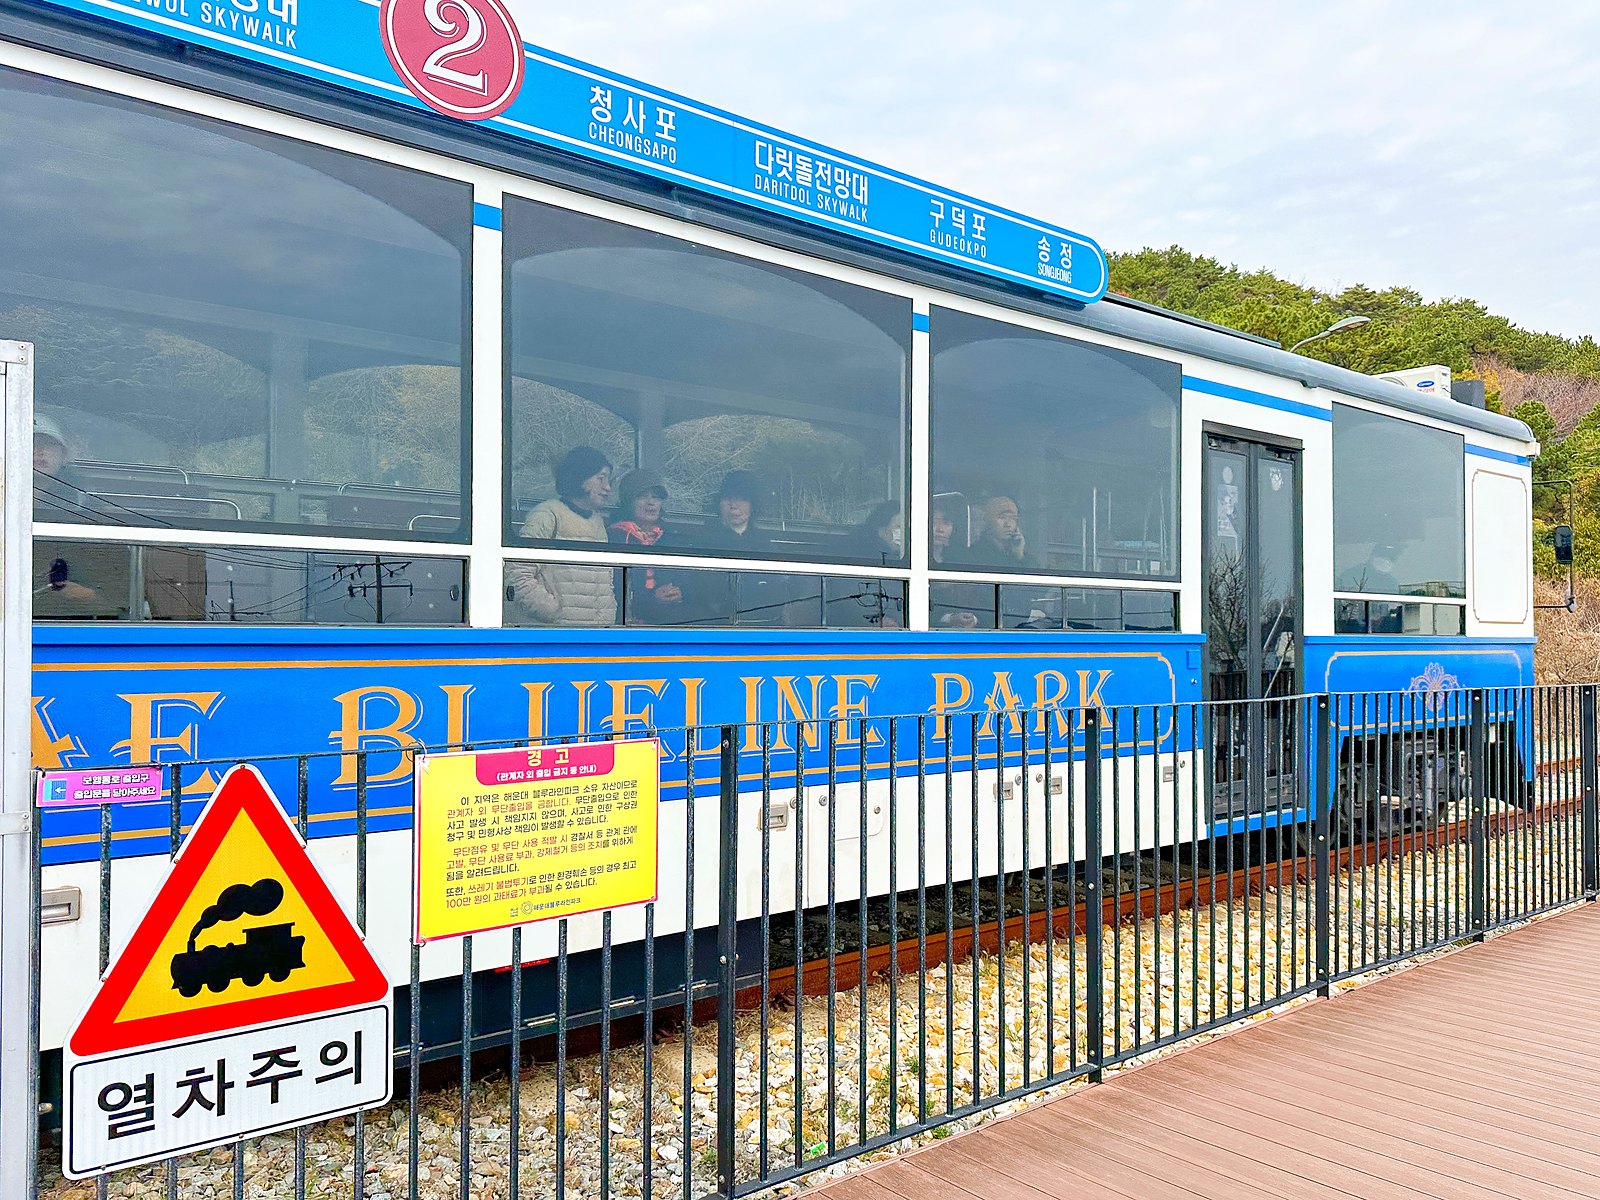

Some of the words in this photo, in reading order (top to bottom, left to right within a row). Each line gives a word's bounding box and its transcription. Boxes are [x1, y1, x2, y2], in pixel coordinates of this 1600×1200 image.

[200, 2, 297, 49] SKYWALK
[421, 0, 489, 97] 2
[588, 121, 677, 164] CHEONGSAPO
[754, 140, 868, 206] 다릿돌전망대
[754, 173, 811, 206] DARITDOL
[817, 193, 868, 223] SKYWALK
[929, 199, 986, 241] 구덕포
[930, 229, 987, 259] GUDEOKPO
[1037, 262, 1072, 285] SONGJEONG
[928, 669, 1114, 744] PARK
[122, 773, 150, 783] 출입구
[496, 771, 524, 782] (관계자
[526, 770, 534, 779] 외
[536, 768, 551, 778] 출입
[553, 767, 568, 777] 금지
[570, 766, 578, 775] 등
[579, 764, 597, 774] 안내)
[74, 789, 111, 799] 출입문을
[112, 786, 157, 798] 닫아주세요
[447, 807, 473, 819] 관계자
[478, 806, 487, 816] 외
[492, 801, 532, 814] 무단출입을
[575, 792, 619, 804] 무단출입으로
[623, 790, 637, 800] 인한
[461, 797, 469, 805] 이
[474, 794, 499, 804] 지역은
[503, 791, 528, 801] 해운대
[533, 786, 579, 798] 블루라인파크
[583, 784, 598, 793] 소유
[602, 780, 637, 791] 자산이므로
[447, 820, 464, 830] 사고
[469, 818, 487, 828] 발생
[491, 816, 500, 825] 시
[504, 812, 537, 823] 책임지지
[571, 805, 594, 816] 사고로
[598, 804, 612, 813] 인한
[616, 800, 638, 811] 구상권
[447, 831, 464, 842] 청구
[467, 830, 475, 840] 및
[478, 826, 512, 839] 민형사상
[514, 823, 539, 833] 책임이
[541, 820, 564, 830] 발생할
[567, 819, 574, 828] 수
[577, 815, 608, 826] 있습니다.
[447, 859, 466, 870] 고발,
[469, 856, 486, 866] 무단
[488, 852, 513, 864] 사용료
[516, 850, 535, 861] 부과,
[537, 845, 568, 857] 강제철거
[570, 843, 585, 853] 등의
[588, 839, 609, 850] 조치를
[453, 844, 487, 857] 무단점유
[491, 843, 499, 852] 및
[503, 840, 519, 850] 무단
[523, 838, 538, 848] 사용
[542, 835, 557, 845] 적발
[560, 834, 568, 843] 시
[571, 831, 593, 842] 경찰서
[596, 829, 603, 839] 등
[606, 827, 621, 837] 관계
[446, 870, 464, 881] 됨을
[466, 863, 519, 879] 알려드립니다.
[446, 886, 466, 897] 또한,
[468, 882, 493, 894] 쓰레기
[496, 875, 537, 890] 불법투기로
[539, 873, 555, 883] 인한
[557, 868, 587, 881] 환경훼손
[589, 865, 604, 875] 등의
[606, 862, 621, 873] 경우
[622, 860, 637, 870] 최고
[446, 896, 471, 909] 100만
[474, 894, 491, 905] 원의
[493, 888, 527, 902] 과태료가
[529, 884, 553, 895] 부과될
[555, 883, 563, 891] 수
[565, 877, 598, 890] 있습니다.
[97, 1030, 363, 1141] 열차주의
